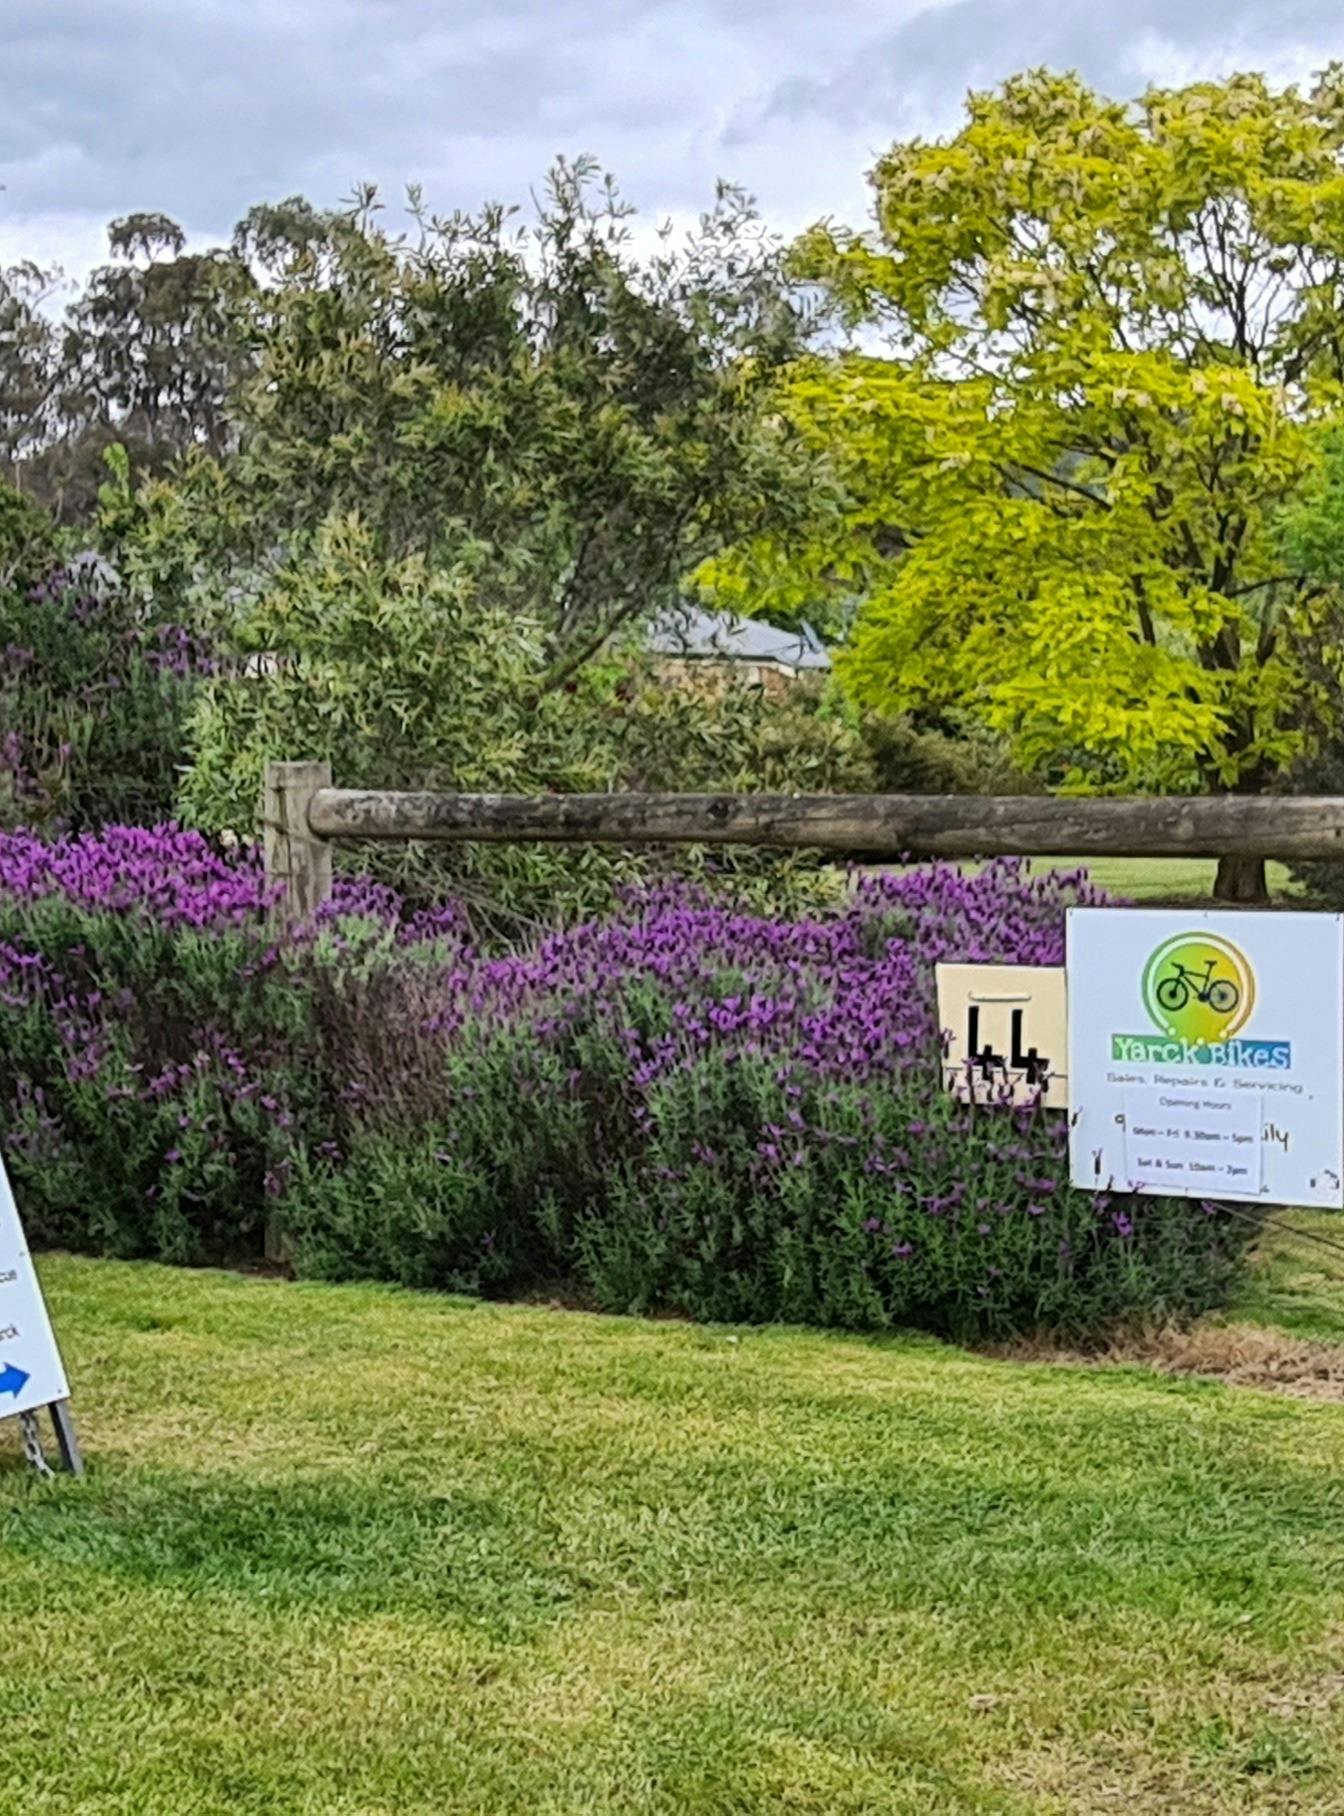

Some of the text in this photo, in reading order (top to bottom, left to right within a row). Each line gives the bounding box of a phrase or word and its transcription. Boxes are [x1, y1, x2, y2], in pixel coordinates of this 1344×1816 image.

[968, 1005, 1050, 1084] 44
[1114, 1036, 1290, 1068] Yarck Bikes
[1107, 1072, 1147, 1085] Sales,
[1154, 1074, 1207, 1088] Repairs
[1233, 1078, 1304, 1094] Servicing
[1159, 1096, 1232, 1110] Opening Hours
[1232, 1133, 1254, 1145] 5pm
[1165, 1159, 1185, 1170] Sun
